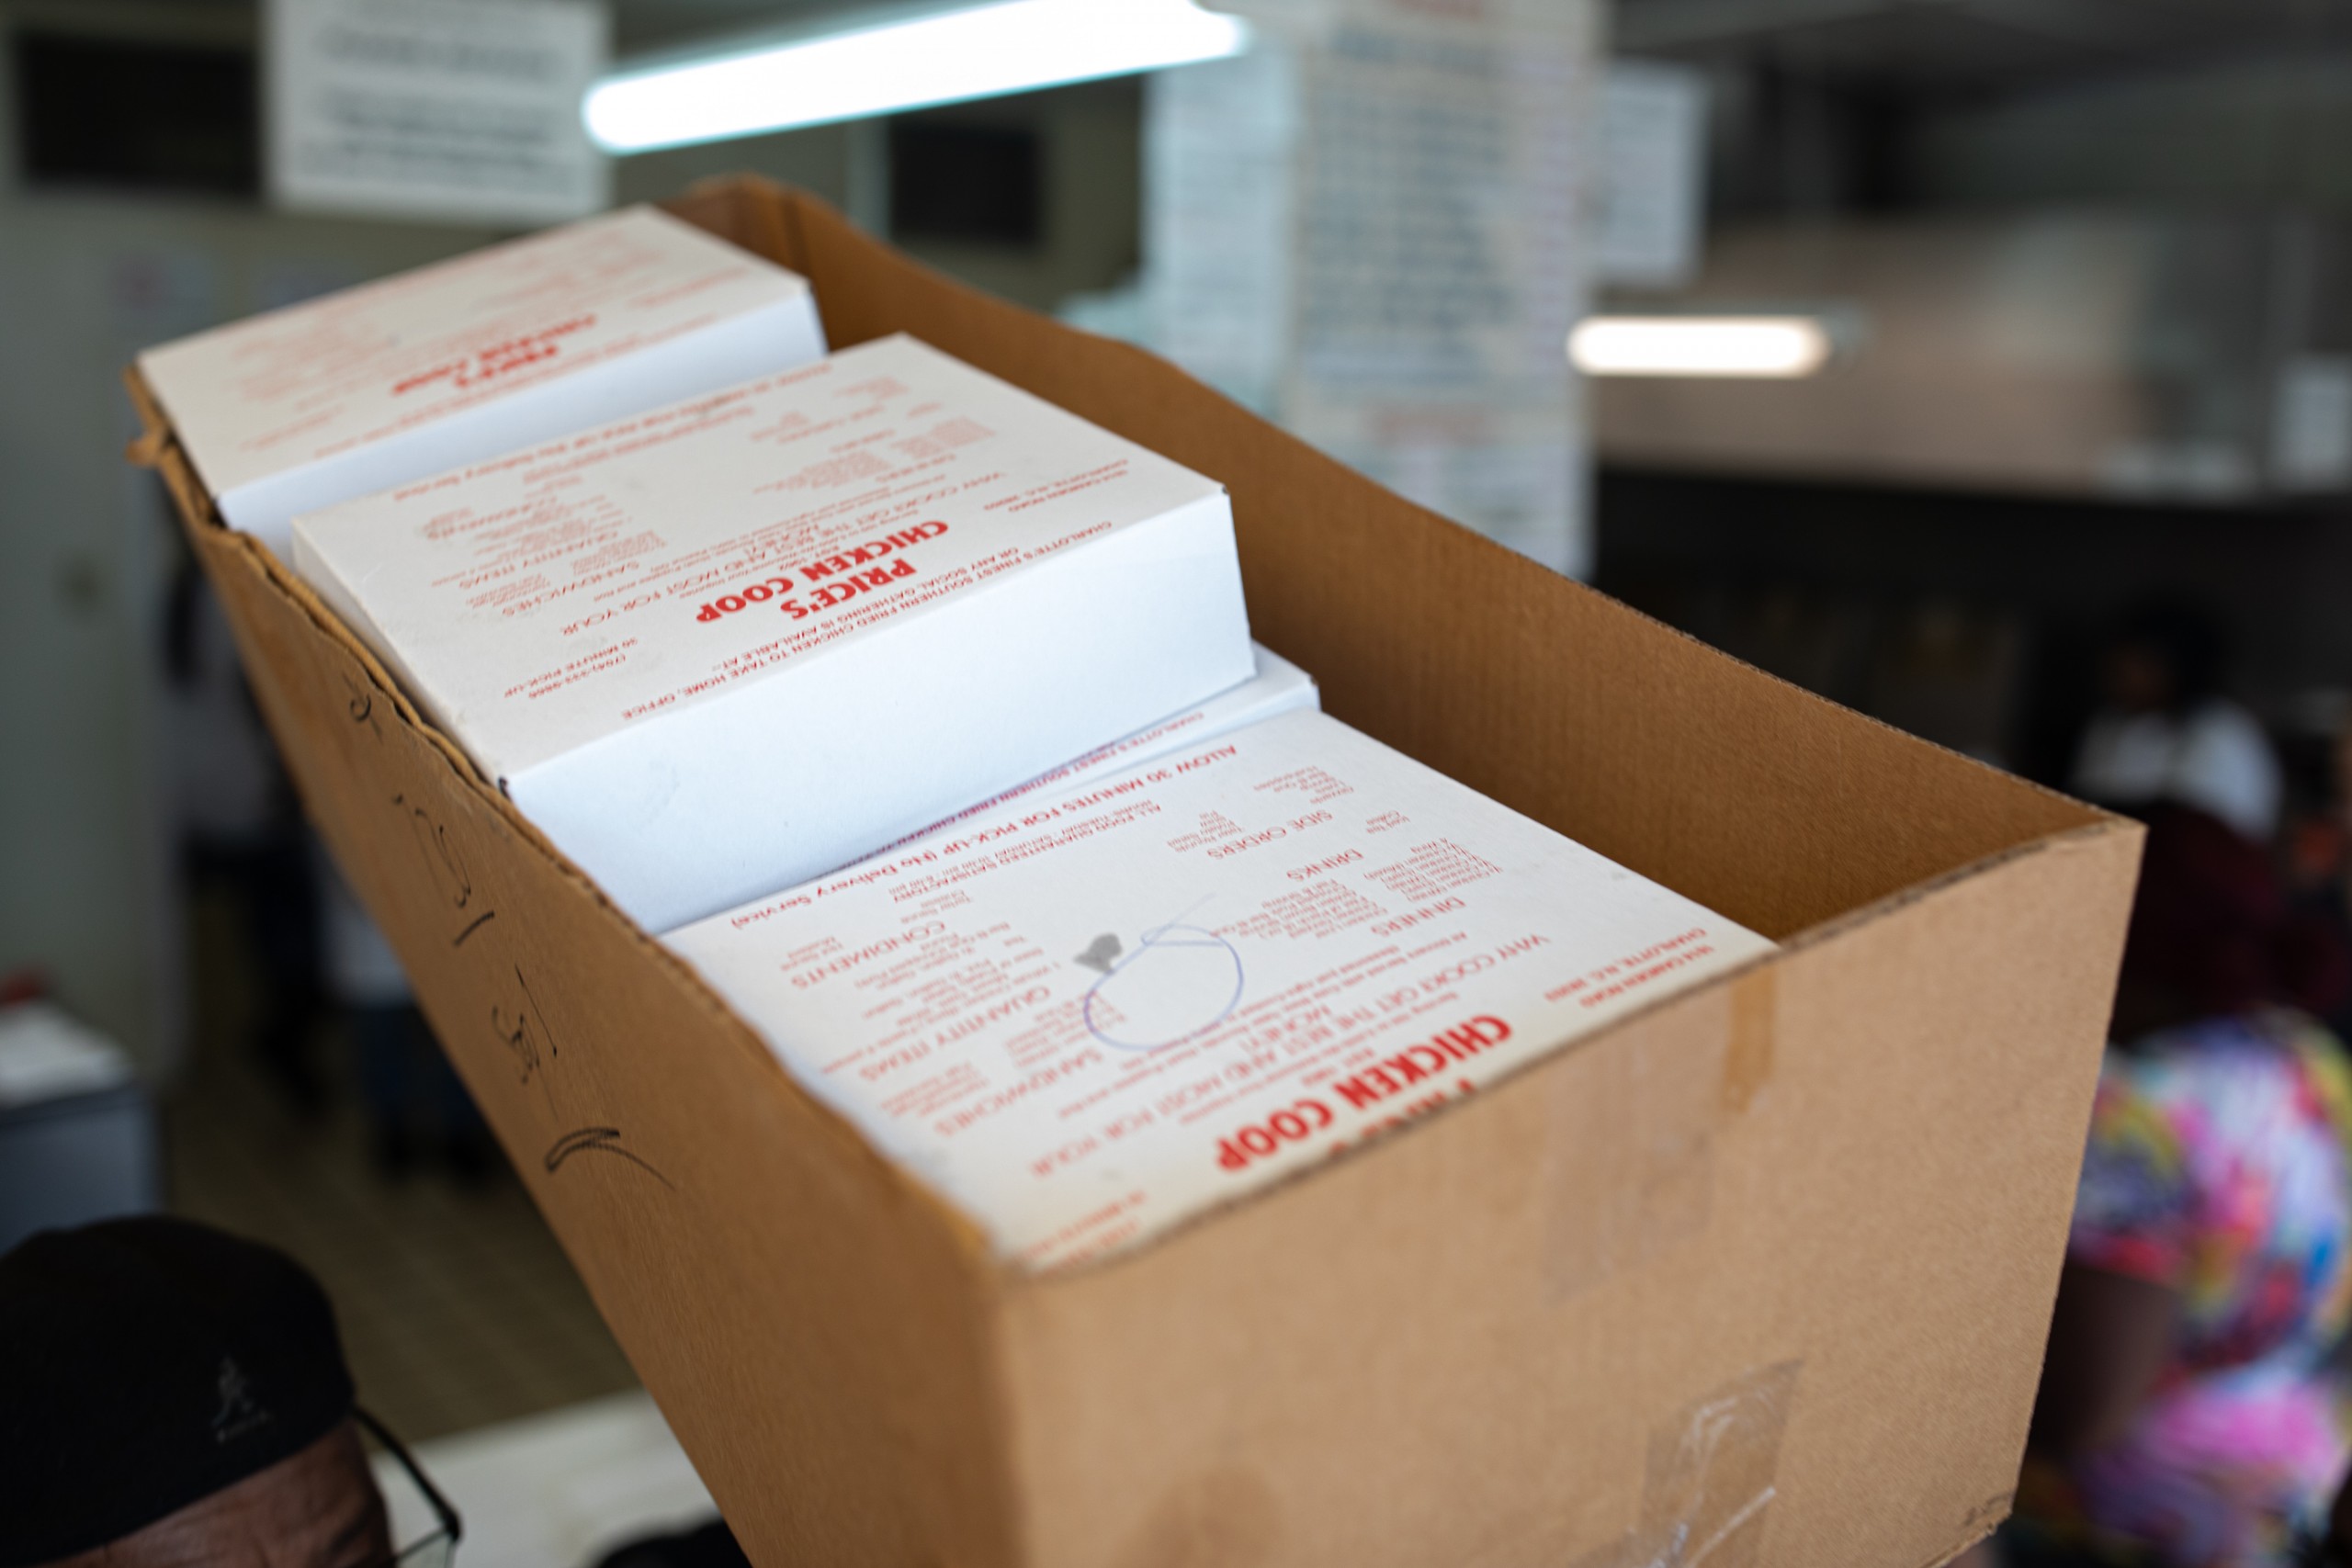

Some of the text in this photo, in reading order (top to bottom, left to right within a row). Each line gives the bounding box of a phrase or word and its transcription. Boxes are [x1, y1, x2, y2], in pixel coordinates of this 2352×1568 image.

[695, 521, 949, 624] CHICKEN COOP
[780, 558, 917, 620] PRICE'S
[622, 521, 1113, 719] CHARLOTTE'S FINEST SOUTHERN FRIED CHICKEN TO TAKE HOME, OFFICE
[744, 547, 1020, 660] OR ANY SOCIAL GATHERING IS AVAILABLE
[561, 608, 616, 637] YOUR
[566, 645, 619, 672] MINUTE
[1140, 766, 1178, 784] 30
[1175, 744, 1237, 773] ALLOW
[1061, 778, 1145, 813] MINUTES
[1022, 807, 1061, 827] FOR
[1094, 812, 1136, 831] FOOD
[1206, 809, 1334, 859] SIDE ORDERS
[943, 822, 1020, 855] PICK-UP
[999, 827, 1094, 865] GUARANTEED
[899, 852, 938, 867] (No
[1286, 849, 1364, 881] DRINKS
[816, 863, 899, 897] Delivery
[893, 861, 998, 904] SATISFACTORY
[729, 896, 813, 930] Service)
[1370, 896, 1467, 937] DINNERS
[790, 921, 946, 988] CONDIMENTS
[1498, 934, 1547, 961] WHY
[936, 987, 1051, 1046] QUANTITY
[1378, 988, 1419, 1013] GET
[1336, 1007, 1375, 1031] THE
[1283, 1024, 1335, 1056] BEST
[859, 1042, 931, 1083] ITEMS
[1224, 1048, 1277, 1079] AND
[1332, 1015, 1512, 1111] CHICKEN
[934, 1048, 1103, 1137] SANDWICHES
[1156, 1076, 1222, 1117] MOST
[1216, 1099, 1335, 1172] COOP
